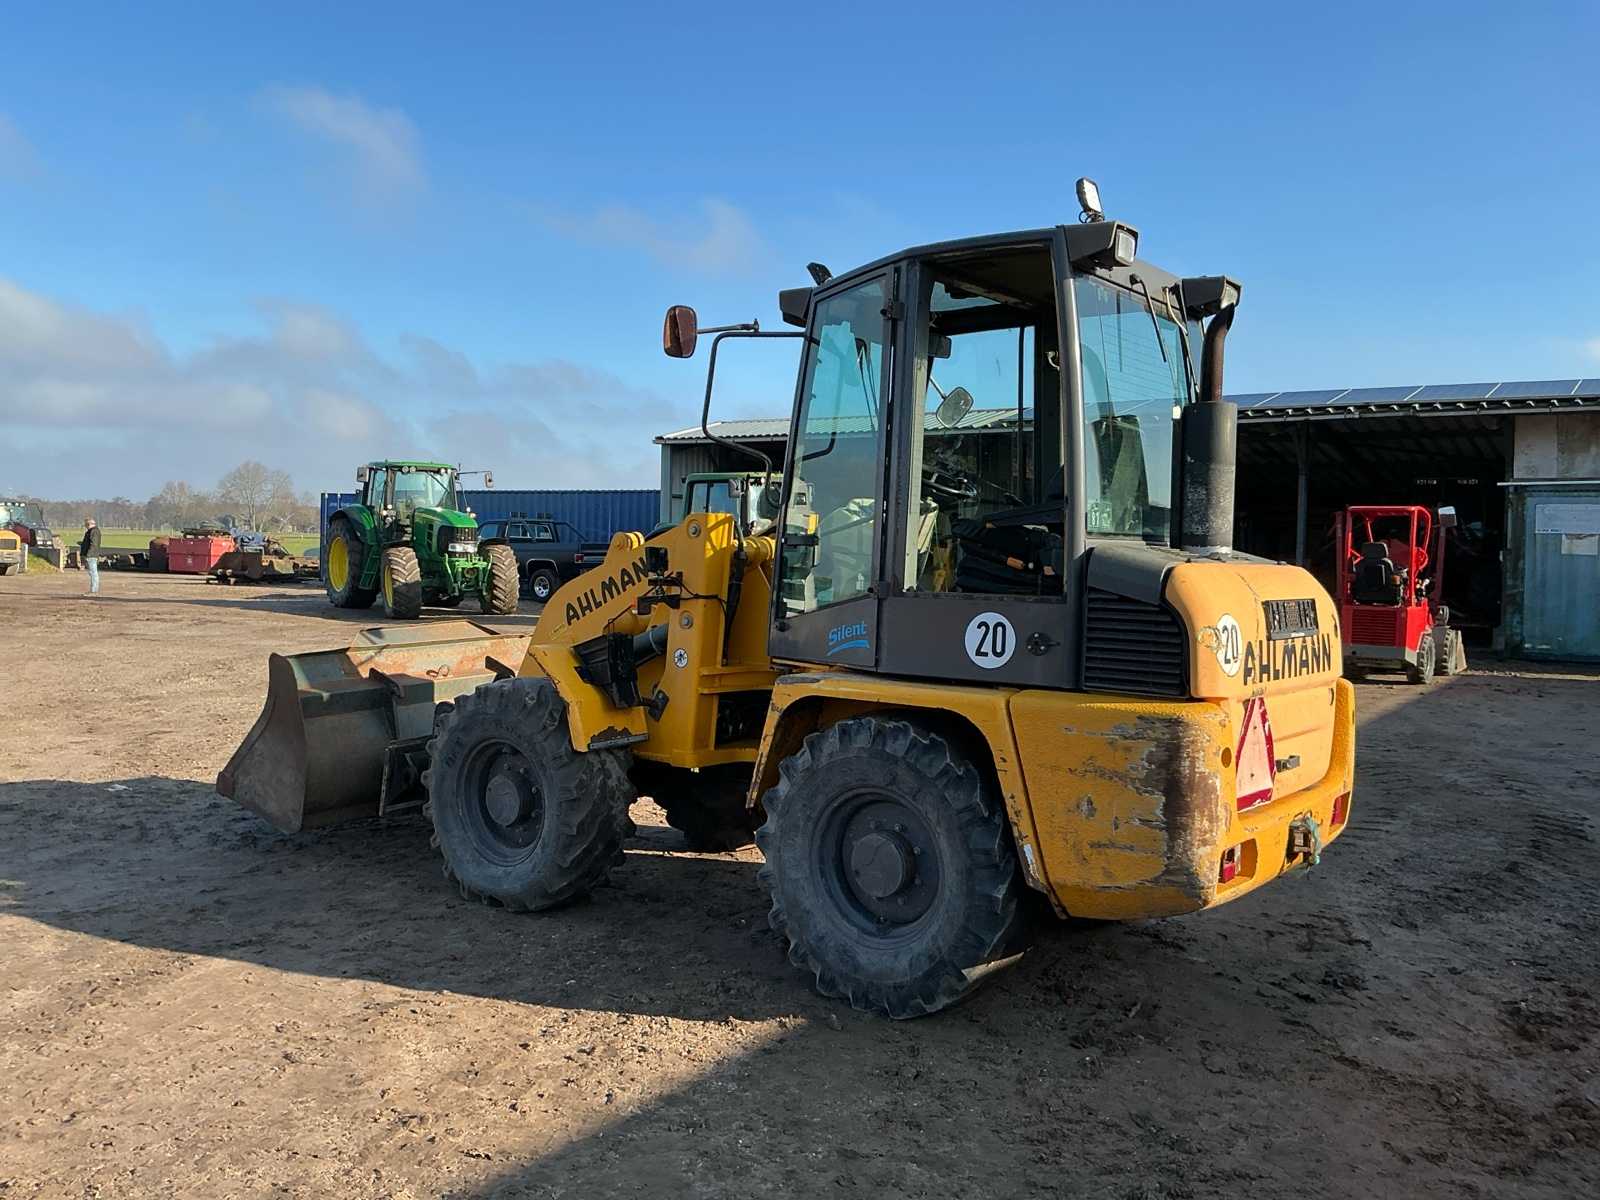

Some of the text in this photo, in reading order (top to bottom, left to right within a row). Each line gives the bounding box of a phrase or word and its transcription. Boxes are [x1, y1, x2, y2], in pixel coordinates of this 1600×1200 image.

[565, 556, 648, 626] AHLMAN
[828, 620, 868, 643] Silent
[974, 620, 1008, 659] 20
[1221, 624, 1239, 665] 20
[1243, 632, 1333, 687] AHLMANN
